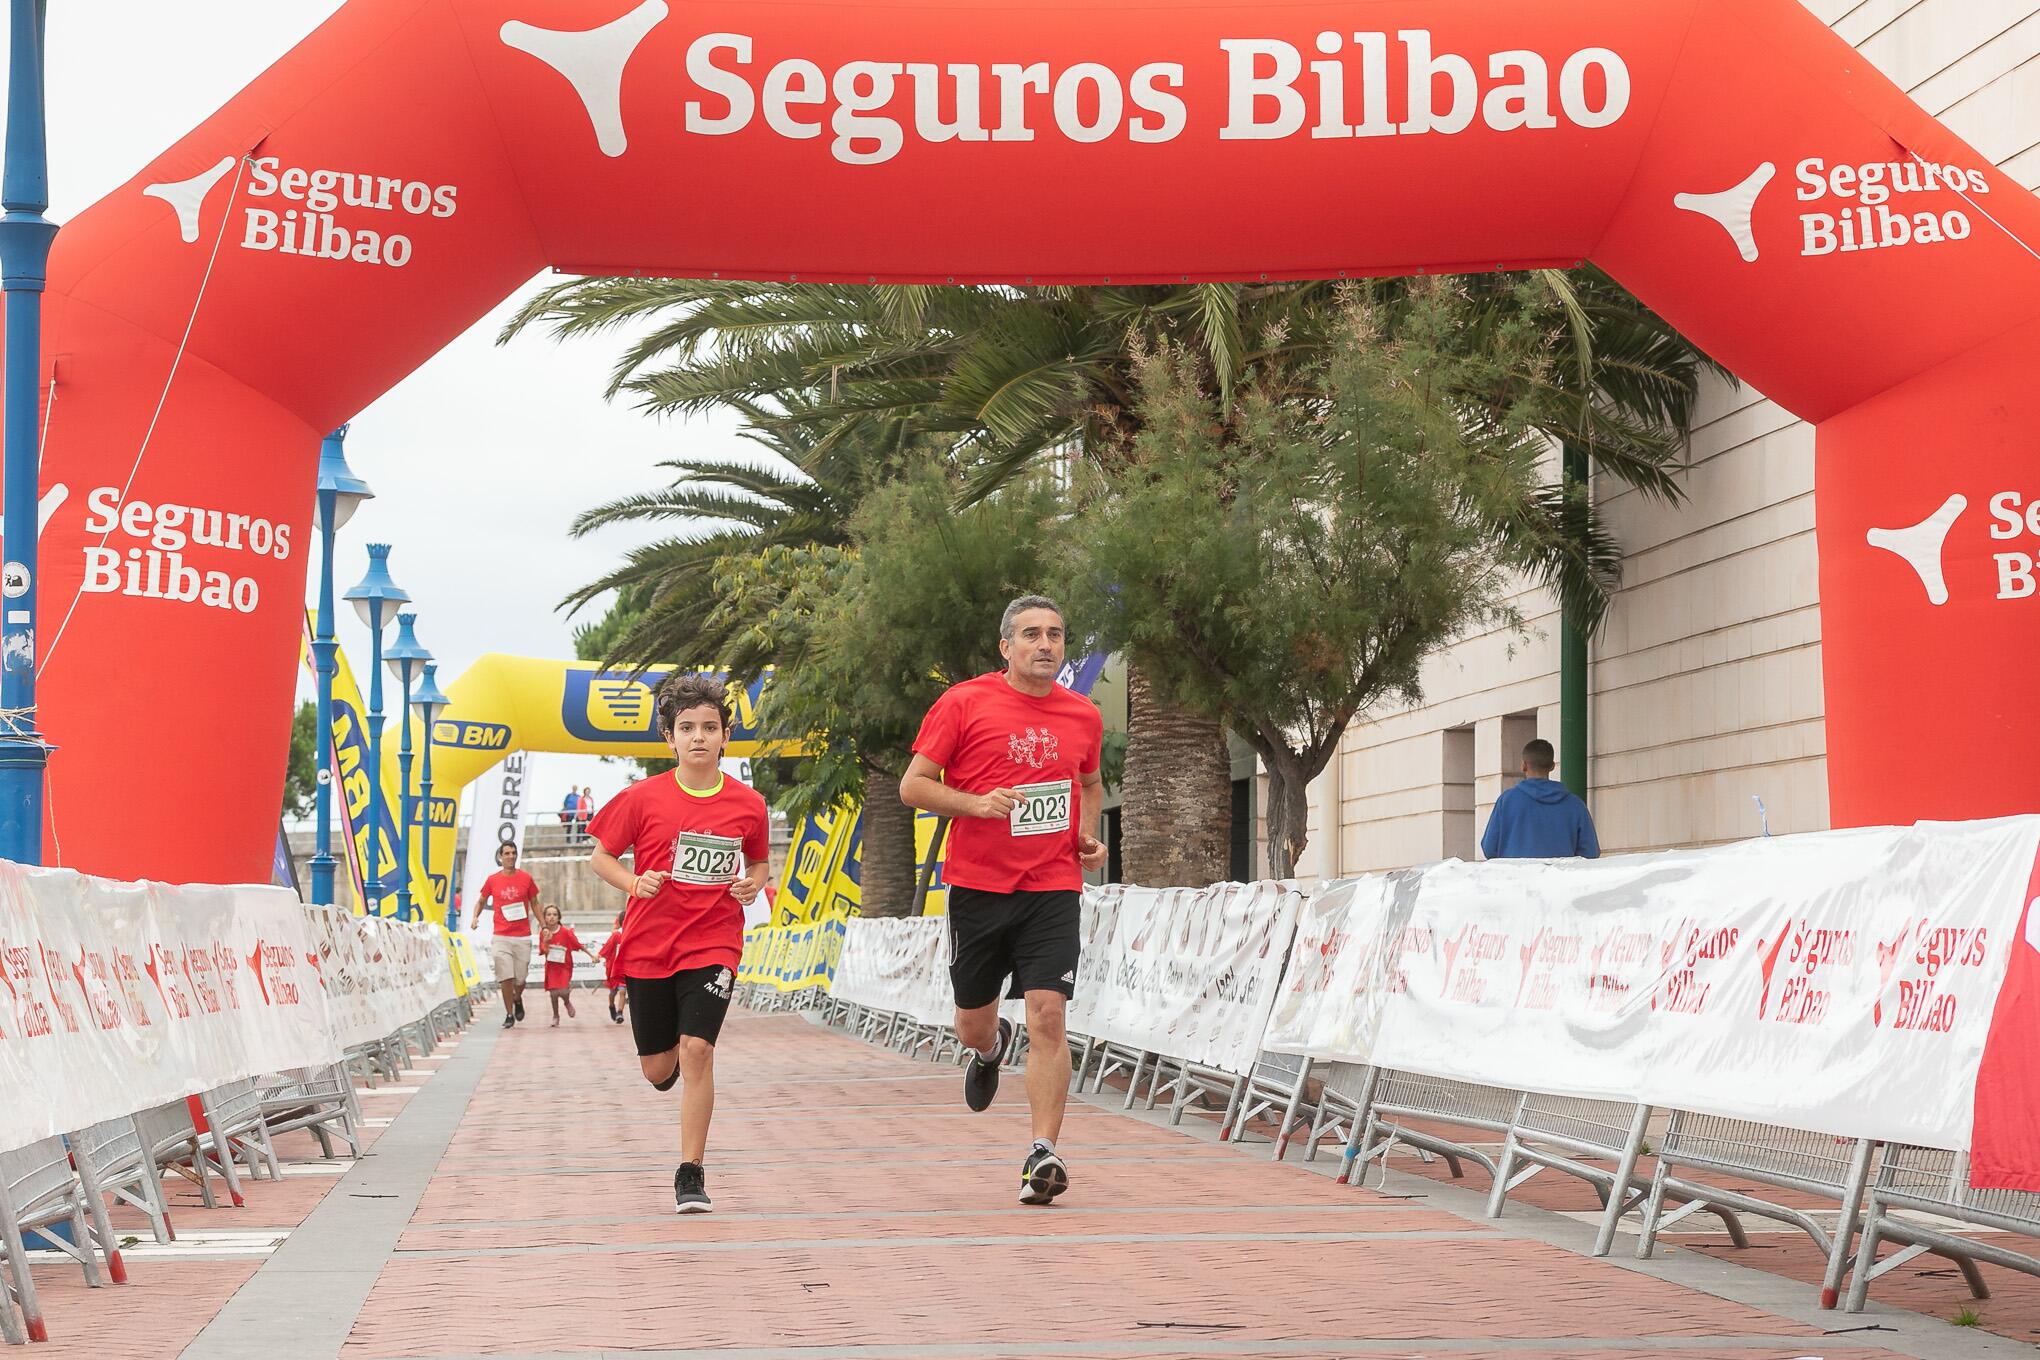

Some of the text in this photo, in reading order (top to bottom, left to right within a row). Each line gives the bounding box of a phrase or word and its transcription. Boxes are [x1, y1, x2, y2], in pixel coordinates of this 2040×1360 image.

[685, 29, 1631, 165] Seguros Bilbao
[245, 156, 457, 218] Seguros
[1795, 156, 1990, 205] Seguros
[240, 207, 412, 267] Bilbao
[1799, 204, 1972, 256] Bilbao
[84, 486, 291, 561] Seguros
[81, 546, 259, 613] Bilbao
[463, 725, 507, 748] BM
[1018, 795, 1067, 823] 2023
[681, 846, 736, 874] 2023
[260, 938, 296, 974] Seguros
[1789, 917, 1858, 975] Seguros
[1915, 917, 1988, 977] Seguros
[1775, 976, 1832, 1026] Bilbao
[1893, 979, 1957, 1033] Bilbao
